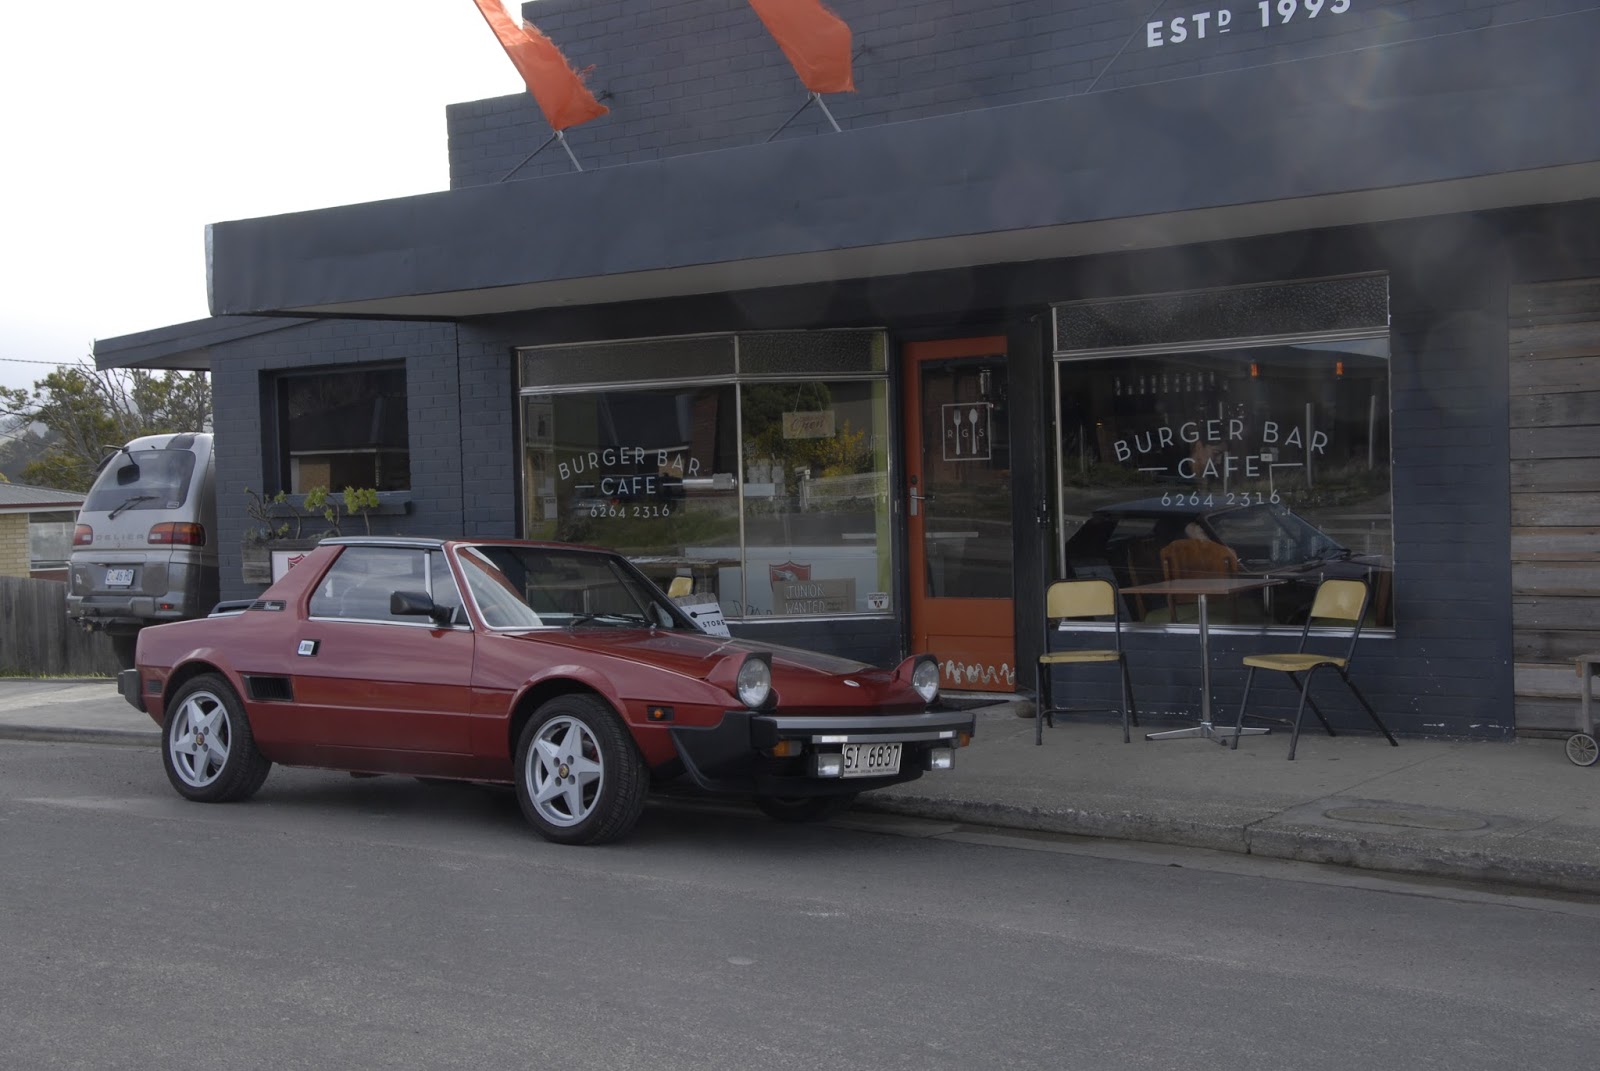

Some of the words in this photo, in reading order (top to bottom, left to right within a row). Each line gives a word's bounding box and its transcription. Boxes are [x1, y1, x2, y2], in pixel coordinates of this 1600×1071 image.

[1113, 419, 1244, 462] BURGER
[1262, 421, 1328, 455] BAR
[558, 446, 646, 481] BURGER
[657, 449, 701, 477] BAR
[1177, 455, 1260, 479] CAFE
[601, 476, 657, 496] CAFE
[1161, 491, 1215, 508] 6264
[1226, 489, 1281, 507] 2316
[590, 505, 626, 519] 6264
[633, 504, 670, 519] 2316
[785, 600, 826, 615] WANTED
[702, 619, 726, 629] STORE
[867, 744, 900, 768] 6837
